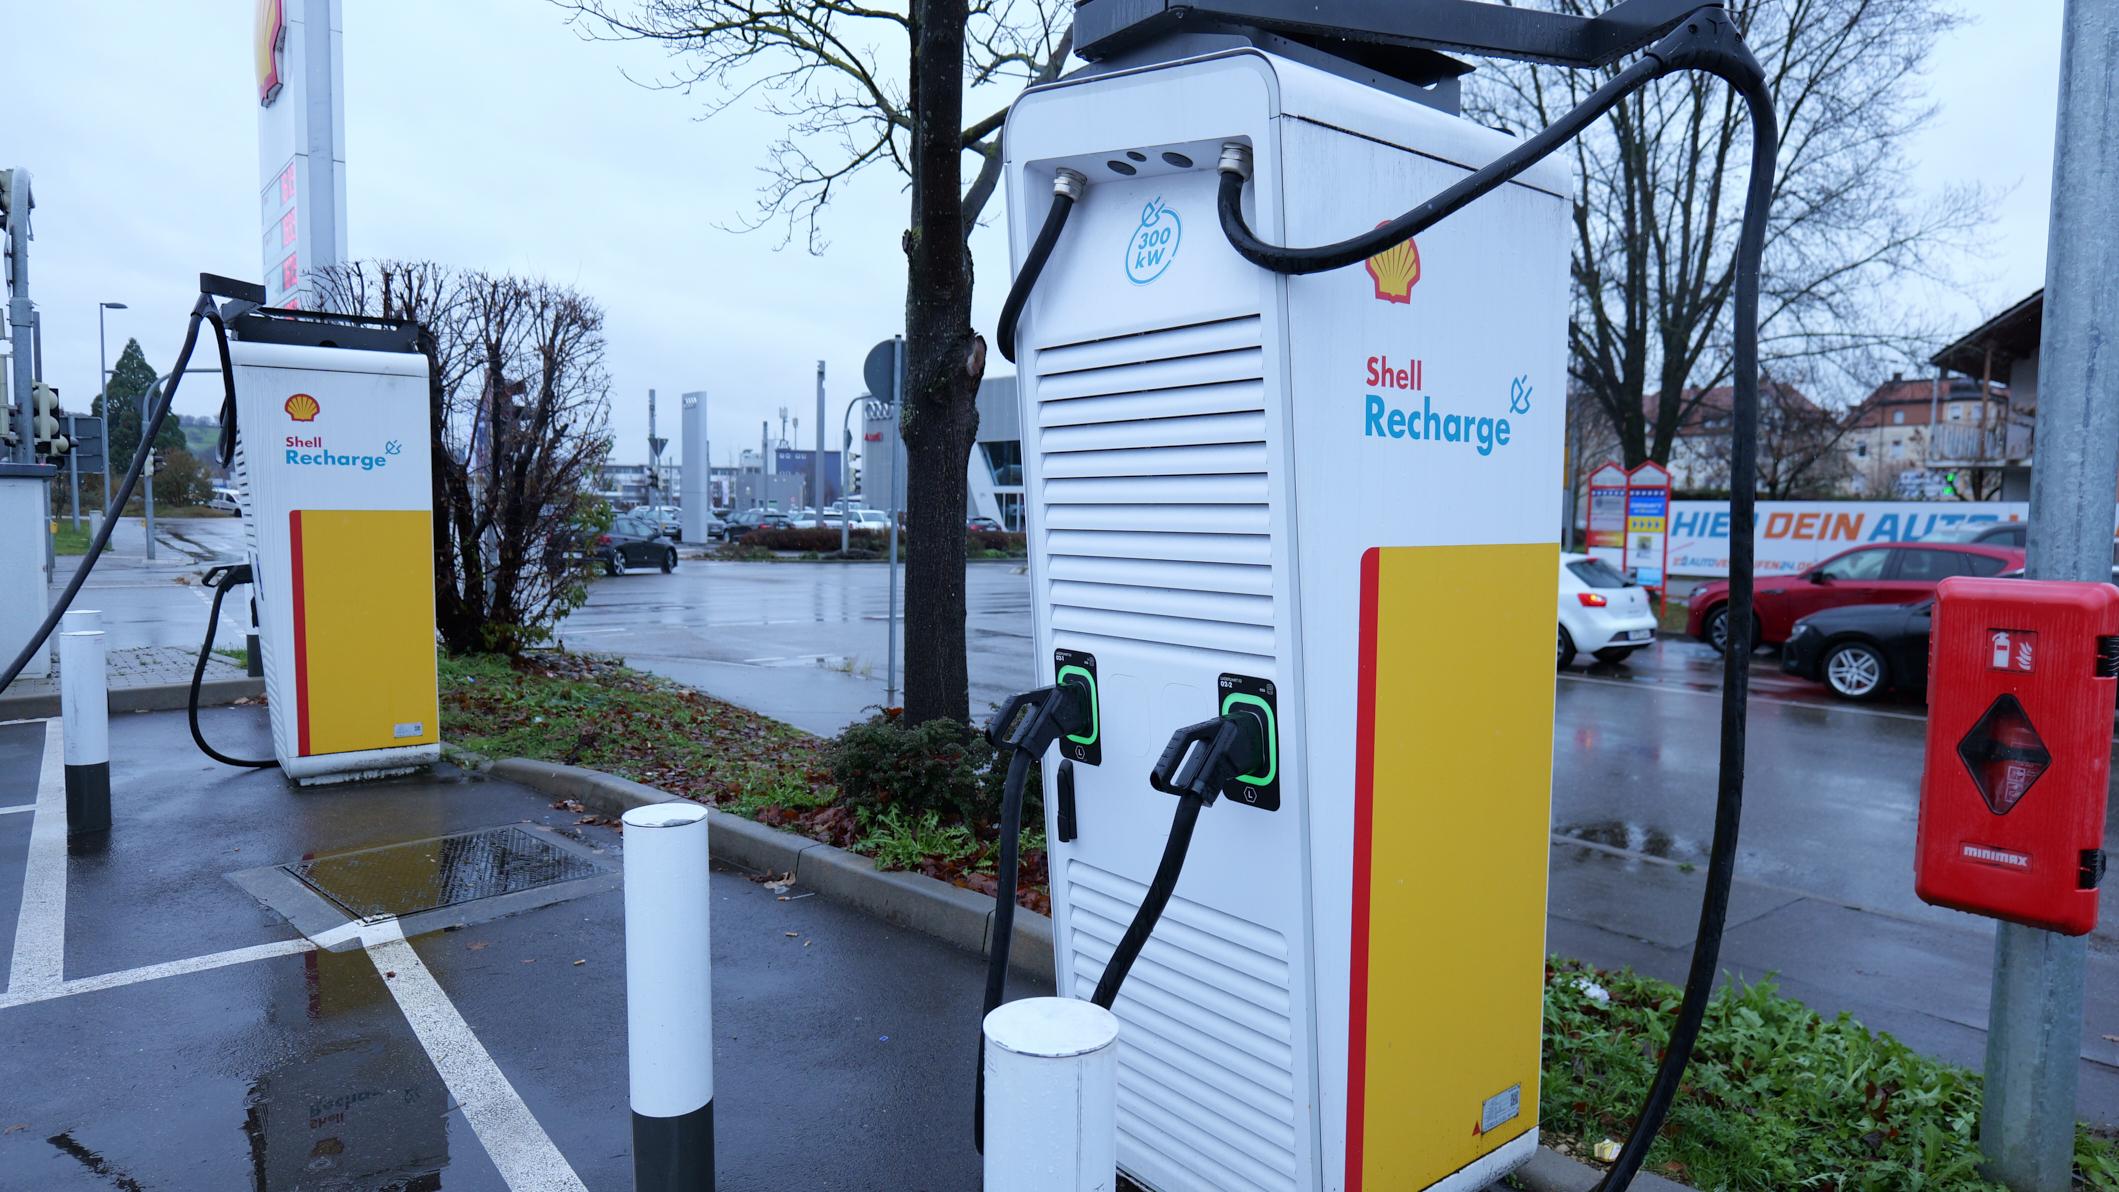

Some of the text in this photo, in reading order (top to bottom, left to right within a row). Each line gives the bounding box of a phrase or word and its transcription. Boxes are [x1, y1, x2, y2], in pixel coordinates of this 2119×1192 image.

[1138, 227, 1171, 249] 300
[1135, 247, 1166, 269] kW
[1366, 355, 1422, 391] Shell
[1365, 394, 1511, 456] Recharge
[286, 436, 322, 448] Shell
[286, 449, 386, 471] Recharge
[1671, 512, 1999, 542] HIE DEIN AUT
[1963, 846, 2028, 867] minimax
